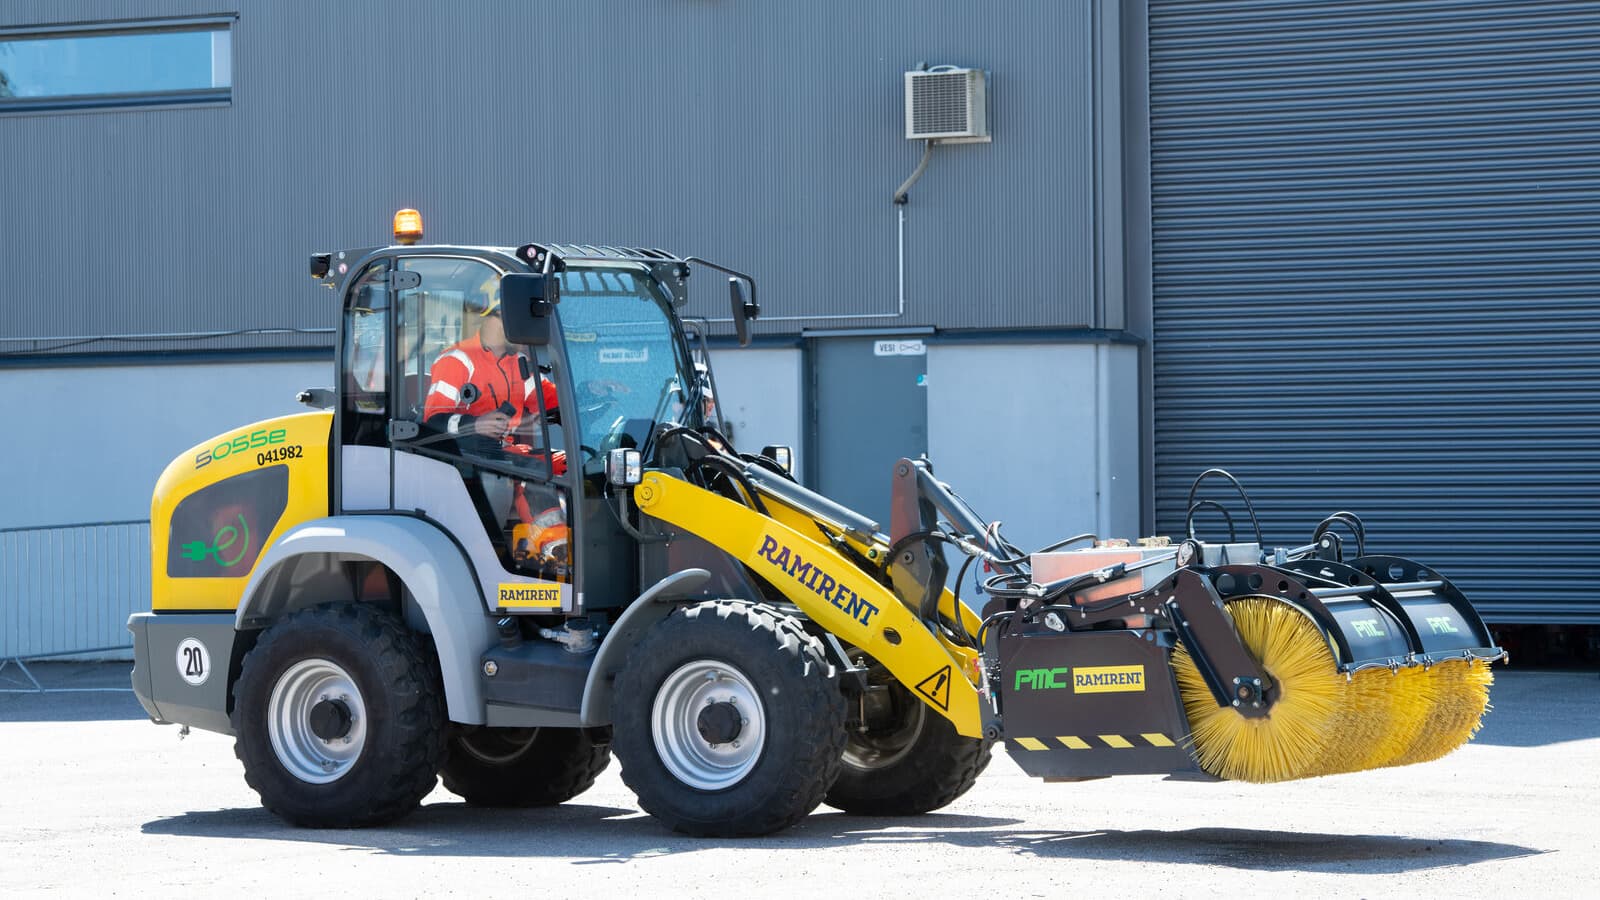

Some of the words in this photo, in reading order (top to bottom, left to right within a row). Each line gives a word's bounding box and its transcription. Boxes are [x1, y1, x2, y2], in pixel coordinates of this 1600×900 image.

[256, 444, 303, 466] 041982
[757, 534, 880, 627] RAMIRENT
[500, 589, 559, 601] RAMIRENT
[1354, 619, 1386, 639] PMC
[1425, 616, 1459, 636] PMC
[183, 646, 204, 678] 20
[1014, 667, 1069, 692] PMC
[1075, 672, 1142, 687] RAMIRENT
